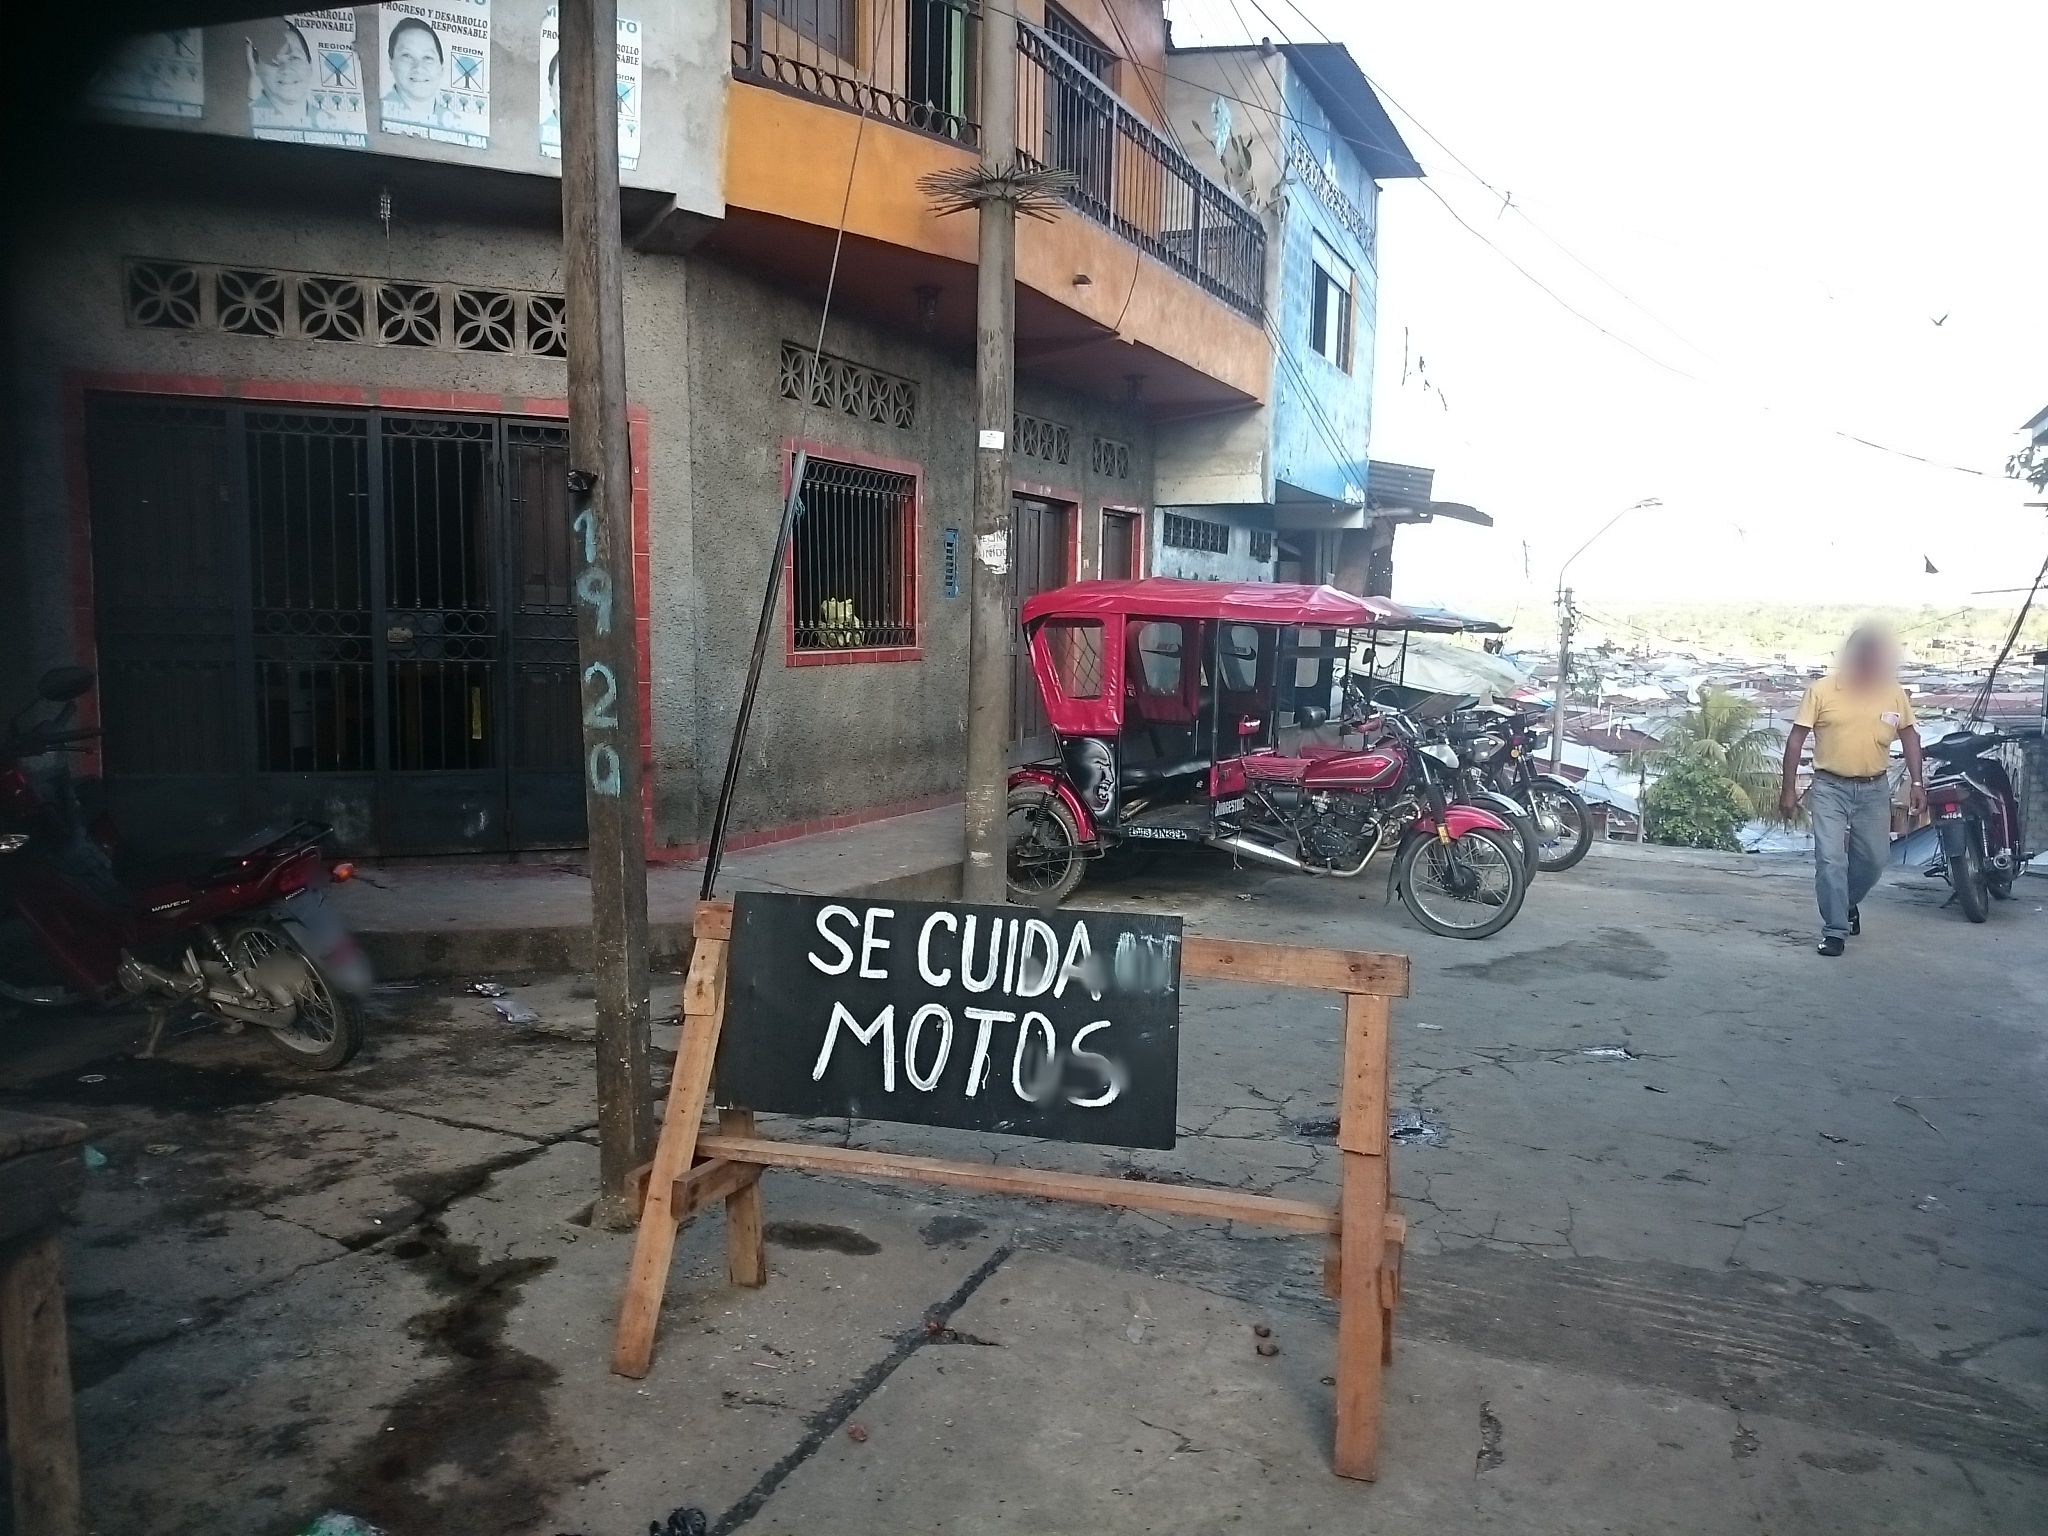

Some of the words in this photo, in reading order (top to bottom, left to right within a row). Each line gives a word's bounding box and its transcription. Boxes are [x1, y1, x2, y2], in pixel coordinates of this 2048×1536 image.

[381, 1, 426, 16] PROGRESO
[427, 9, 434, 18] Y
[435, 10, 488, 29] DESARROLLO
[294, 19, 354, 32] RESPONSABLE
[431, 20, 488, 39] RESPONSABLE
[318, 41, 352, 51] REGION
[451, 45, 484, 56] REGION
[807, 904, 895, 979] SE
[917, 910, 1102, 1001] CUIDA
[811, 1000, 1122, 1108] MOTOS
